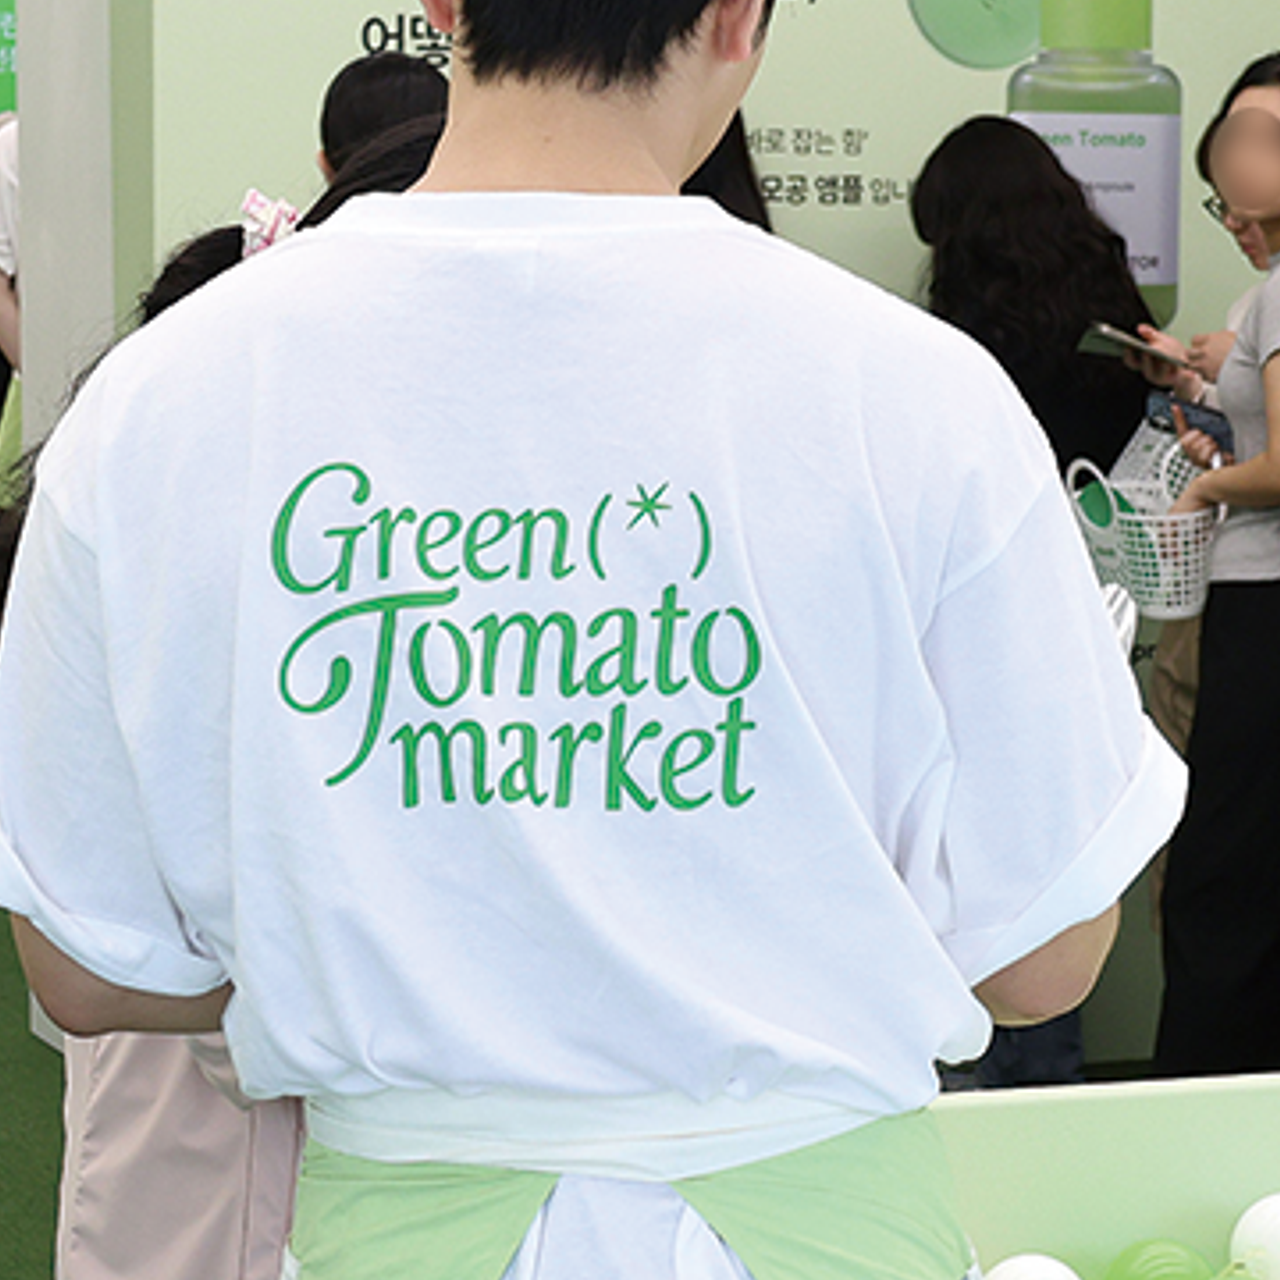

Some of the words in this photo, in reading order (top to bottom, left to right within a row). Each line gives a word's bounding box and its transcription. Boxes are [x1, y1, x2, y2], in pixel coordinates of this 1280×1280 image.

[1079, 130, 1147, 148] Tomato
[278, 583, 762, 787] Tomato
[388, 696, 757, 812] market
